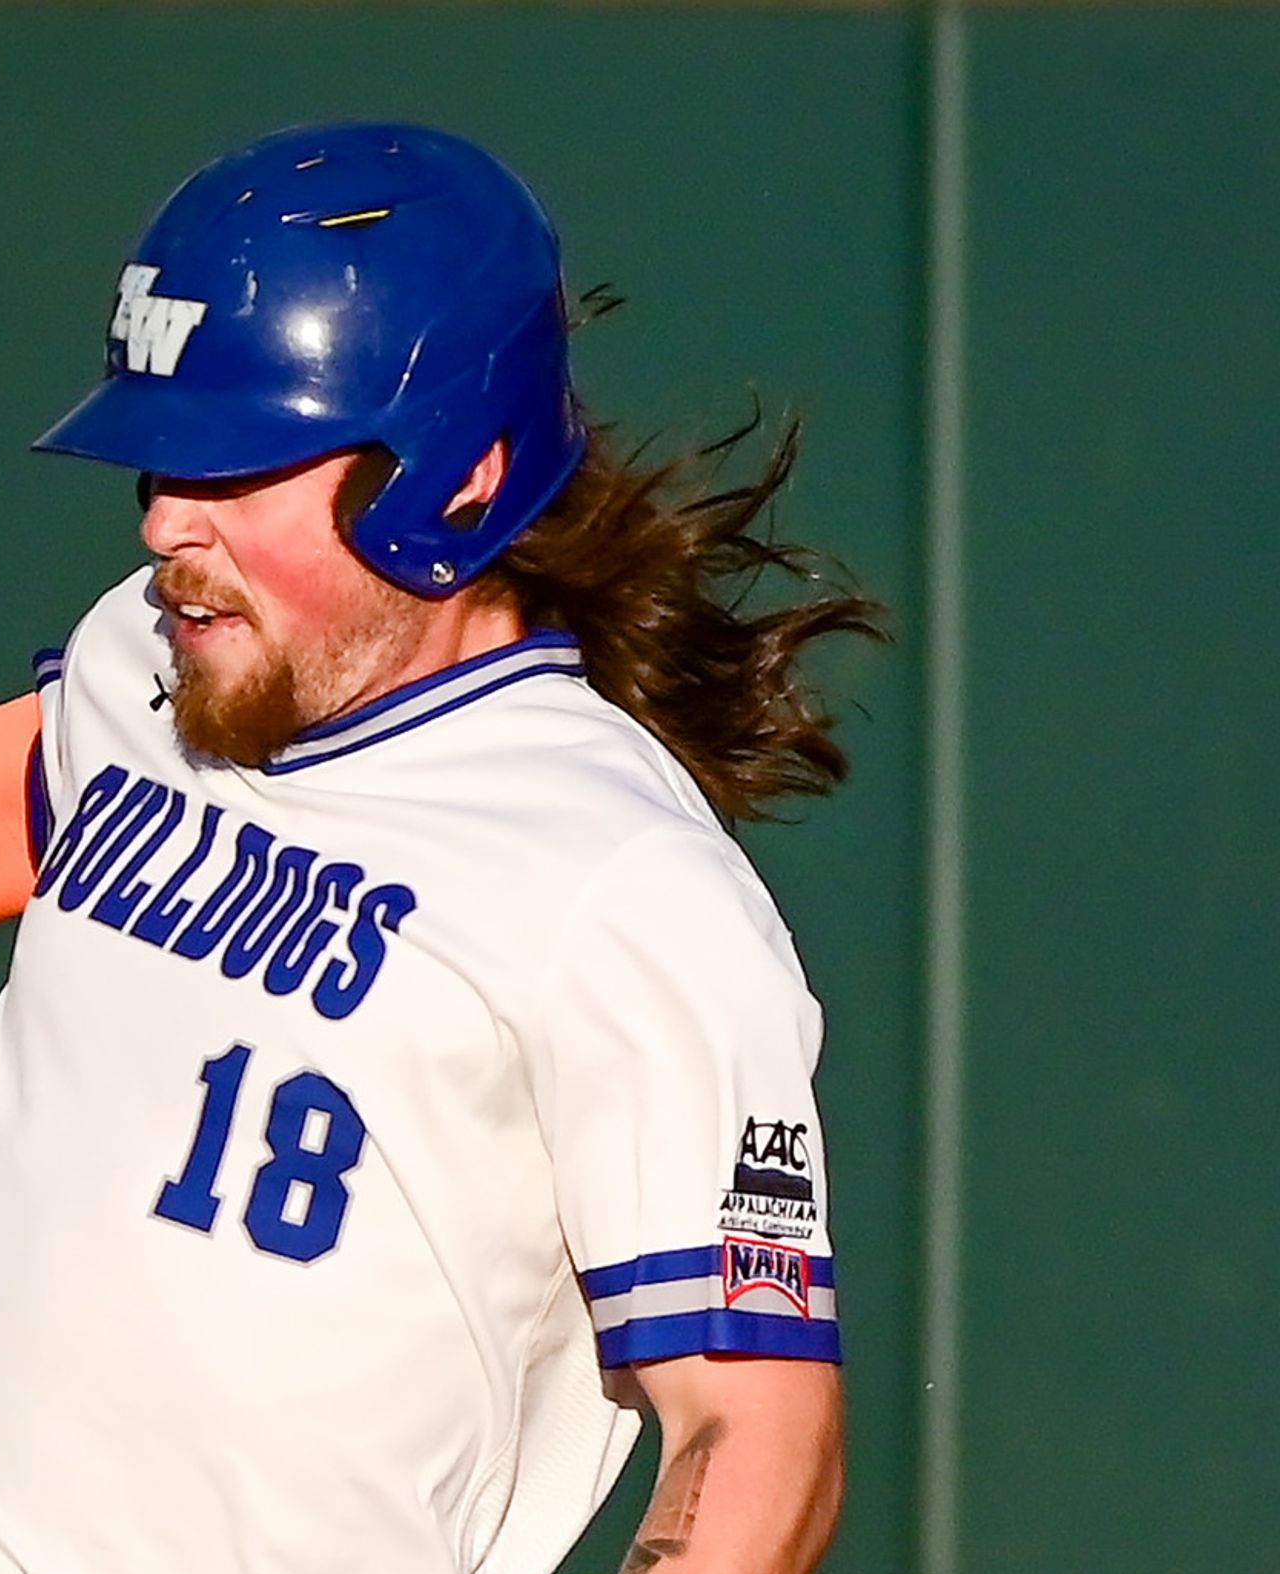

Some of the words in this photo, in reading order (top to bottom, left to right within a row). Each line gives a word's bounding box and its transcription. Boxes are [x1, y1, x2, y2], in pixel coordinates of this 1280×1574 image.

[34, 763, 417, 1021] BULLDOGS
[149, 1040, 370, 1267] 18
[741, 1115, 808, 1171] AAC
[720, 1192, 817, 1222] APPALACHIAN
[729, 1243, 806, 1301] NAIA
